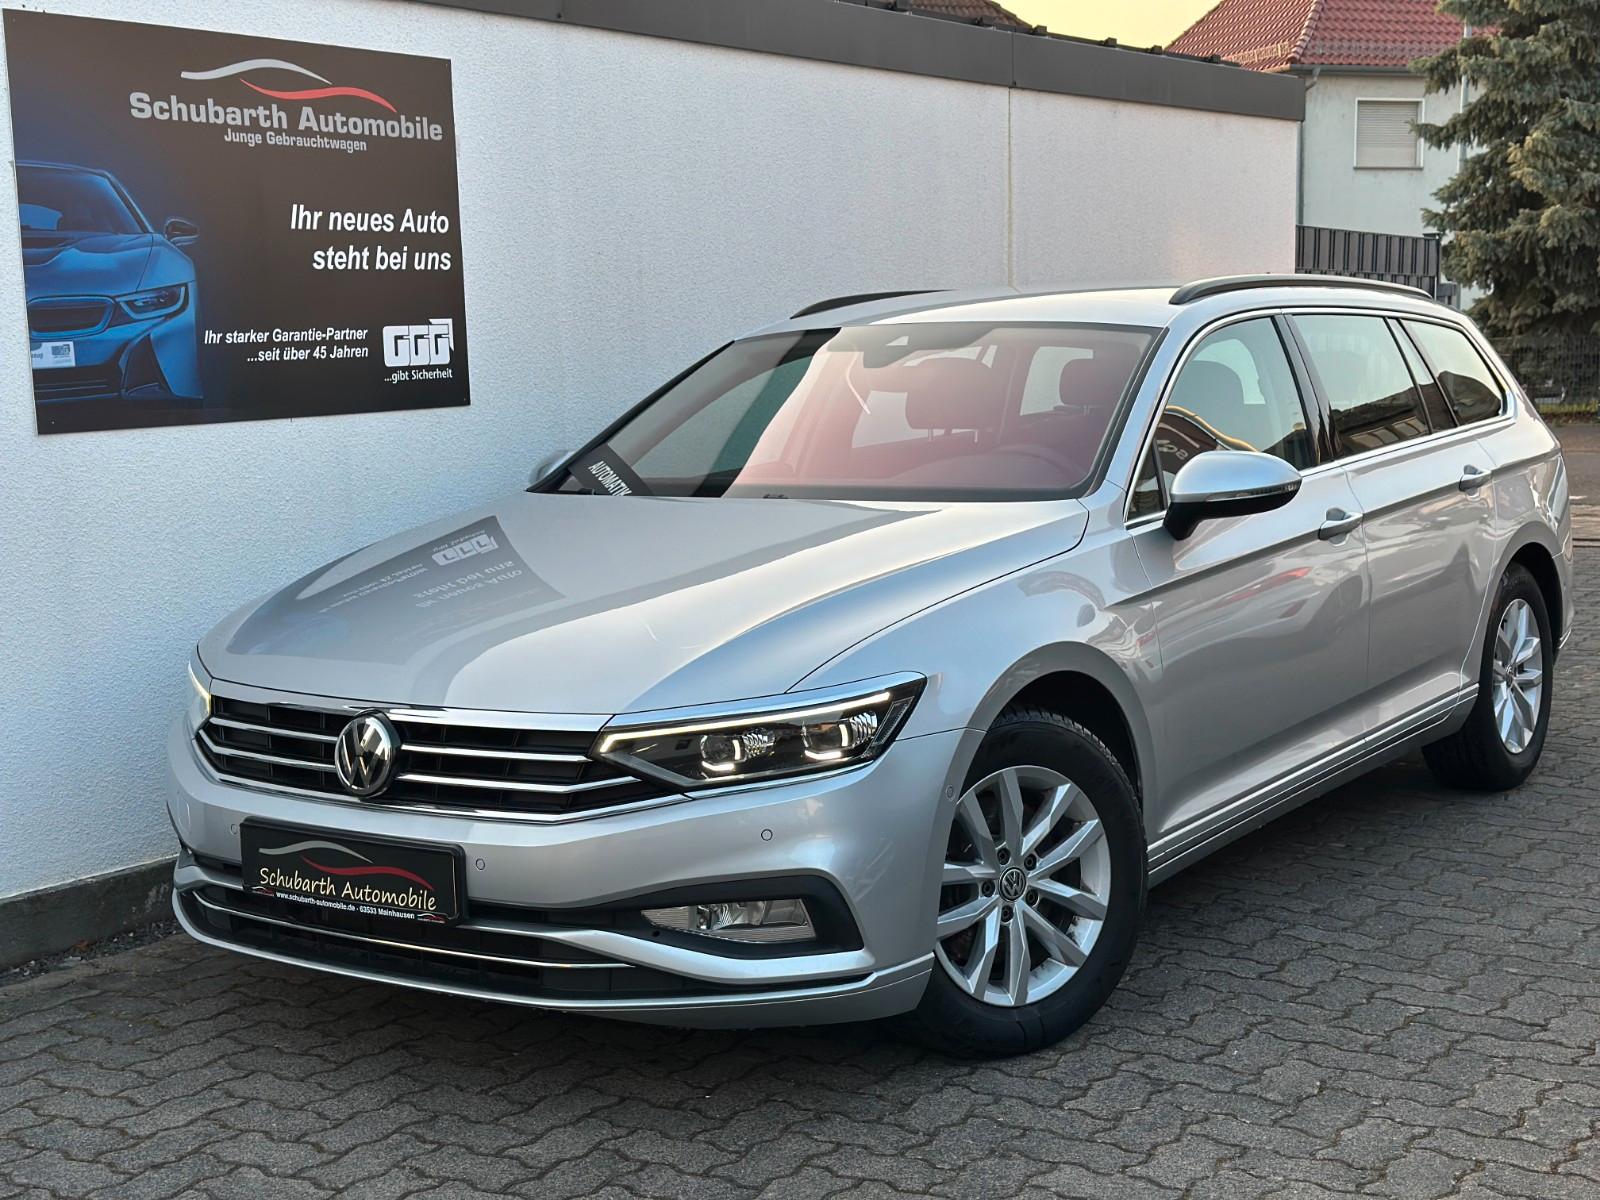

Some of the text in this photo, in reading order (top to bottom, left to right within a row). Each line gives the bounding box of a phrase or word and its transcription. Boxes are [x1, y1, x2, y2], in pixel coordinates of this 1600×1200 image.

[129, 91, 443, 142] Schubarth Automobile
[223, 127, 368, 153] Junge Gebrauchtwagen
[290, 203, 449, 234] Ihr neues Auto
[312, 244, 452, 271] steht bei uns
[204, 327, 369, 345] Ihr starker Garantie-Partner
[247, 344, 369, 362] ...seit über 45 Jahren
[384, 367, 453, 384] ...gibt Sicherheit
[260, 867, 437, 911] Schubarth Automobile
[275, 891, 356, 912] www.schubarth-automobile.de
[359, 905, 378, 915] 63533
[378, 908, 415, 920] Mainhausen
